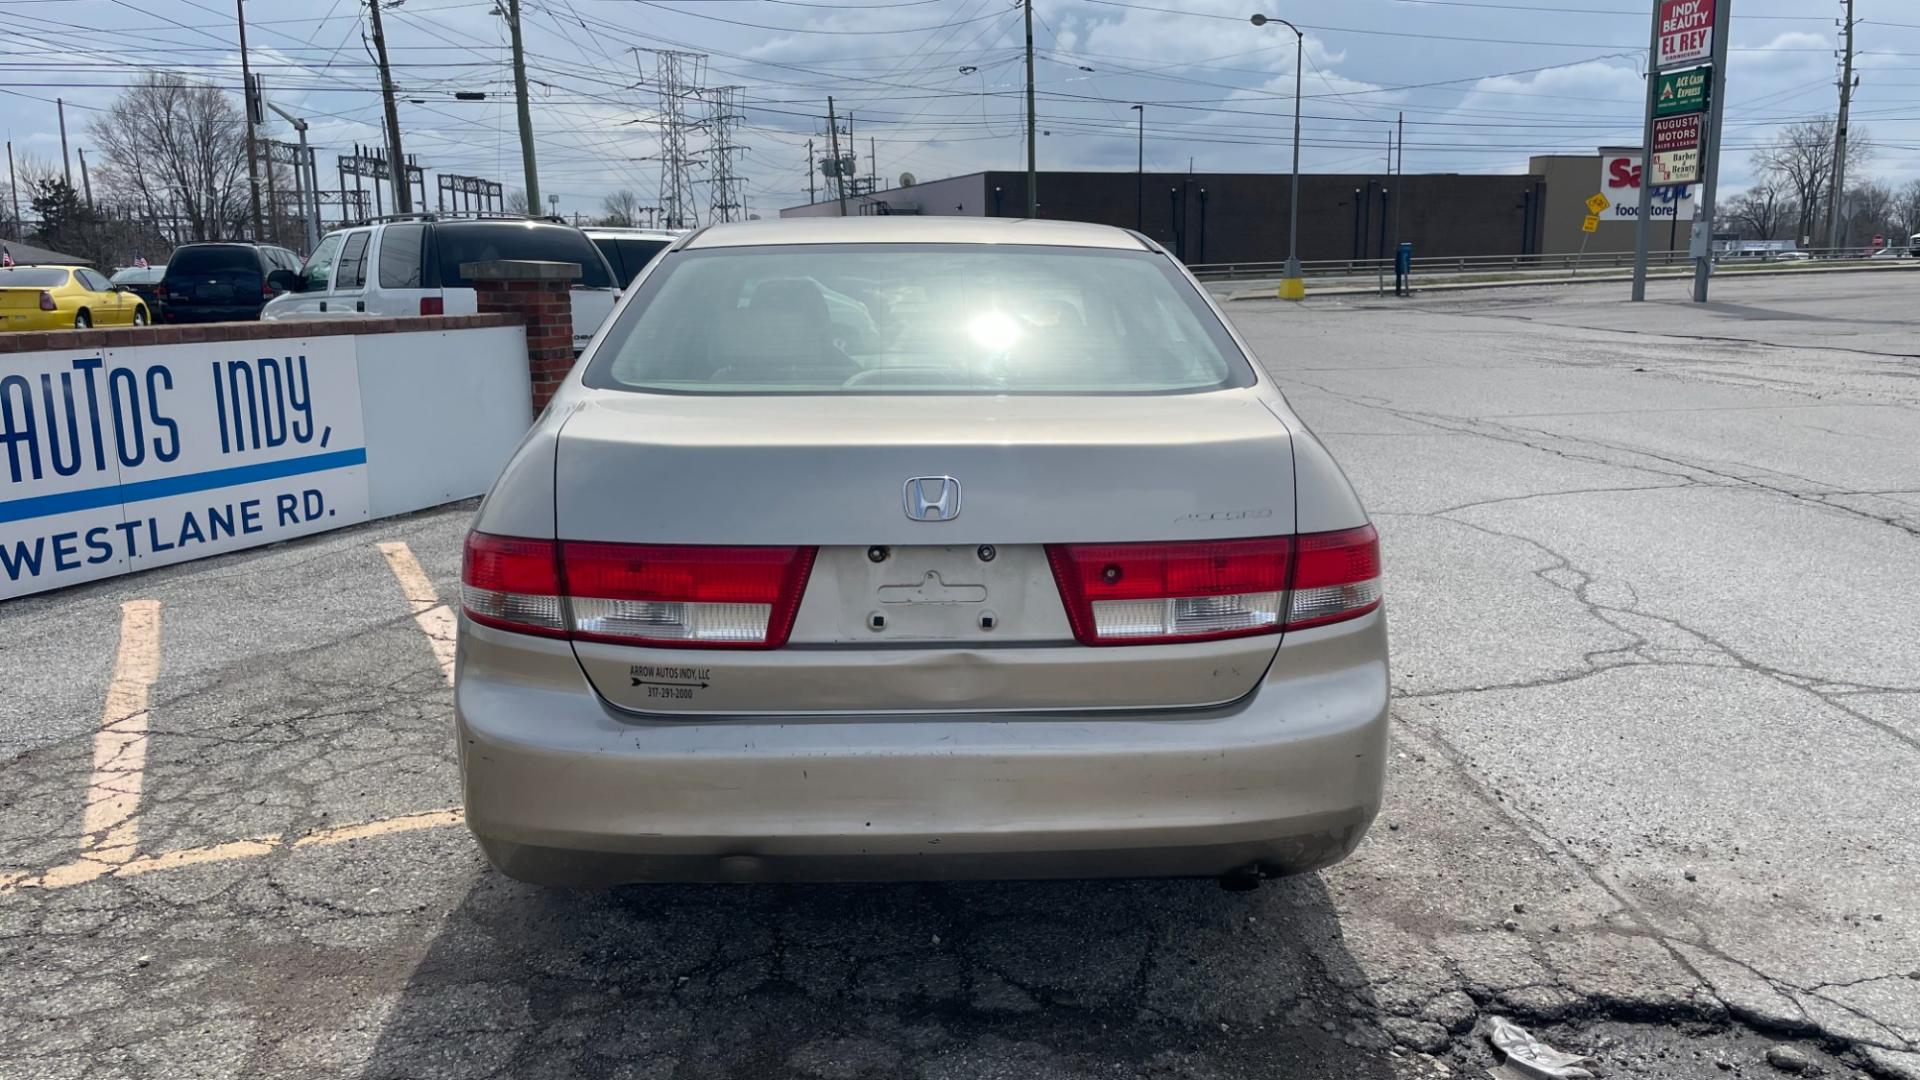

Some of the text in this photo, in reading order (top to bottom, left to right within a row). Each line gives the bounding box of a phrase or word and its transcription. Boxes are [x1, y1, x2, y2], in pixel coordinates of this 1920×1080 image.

[1672, 0, 1700, 18] INDY
[1663, 11, 1708, 33] BEAUTY
[1662, 30, 1707, 55] EL REY
[1656, 116, 1699, 130] AUGUSTA
[1658, 129, 1696, 141] MOTORS
[1673, 152, 1696, 161] Barber
[1672, 165, 1695, 173] Beauty
[0, 358, 181, 483] AUTOS
[0, 488, 336, 581] WESTLANE RD.
[630, 665, 655, 677] ARROW
[656, 667, 679, 679] AUTOS
[698, 669, 711, 680] LLC
[647, 687, 693, 699] 317-291-2000
